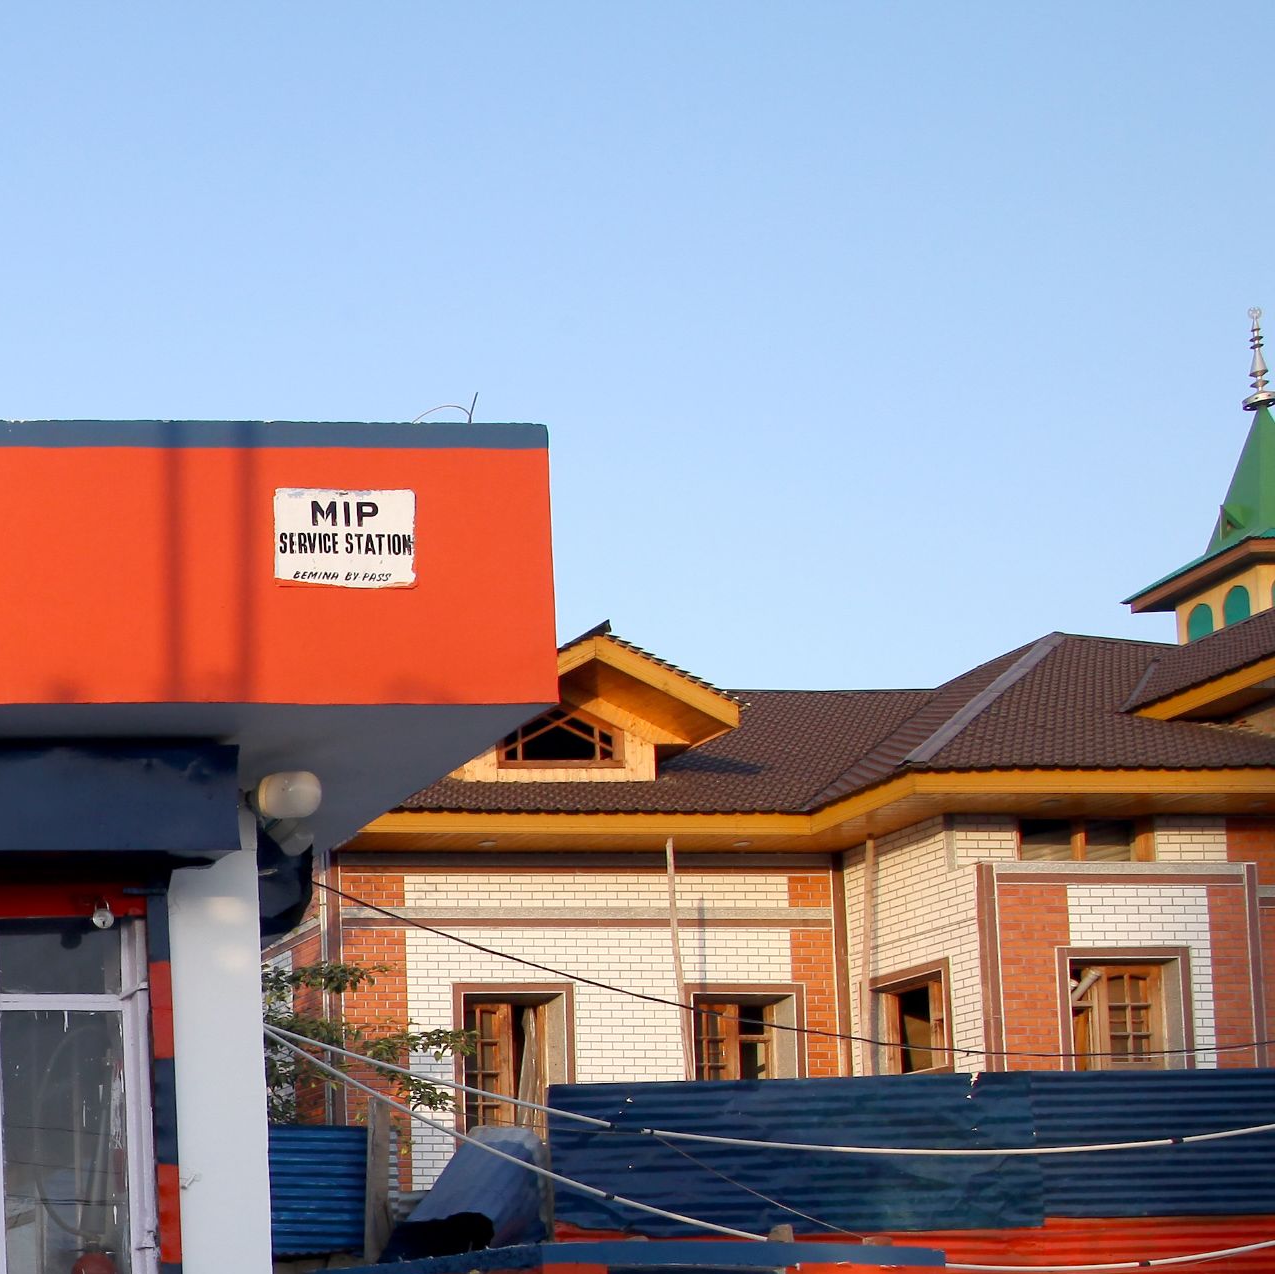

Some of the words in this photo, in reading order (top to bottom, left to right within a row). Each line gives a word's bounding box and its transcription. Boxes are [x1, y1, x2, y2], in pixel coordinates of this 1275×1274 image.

[311, 501, 379, 527] MIP
[279, 532, 338, 554] SERVICE
[345, 533, 412, 555] STATION
[293, 570, 339, 581] BEMINA
